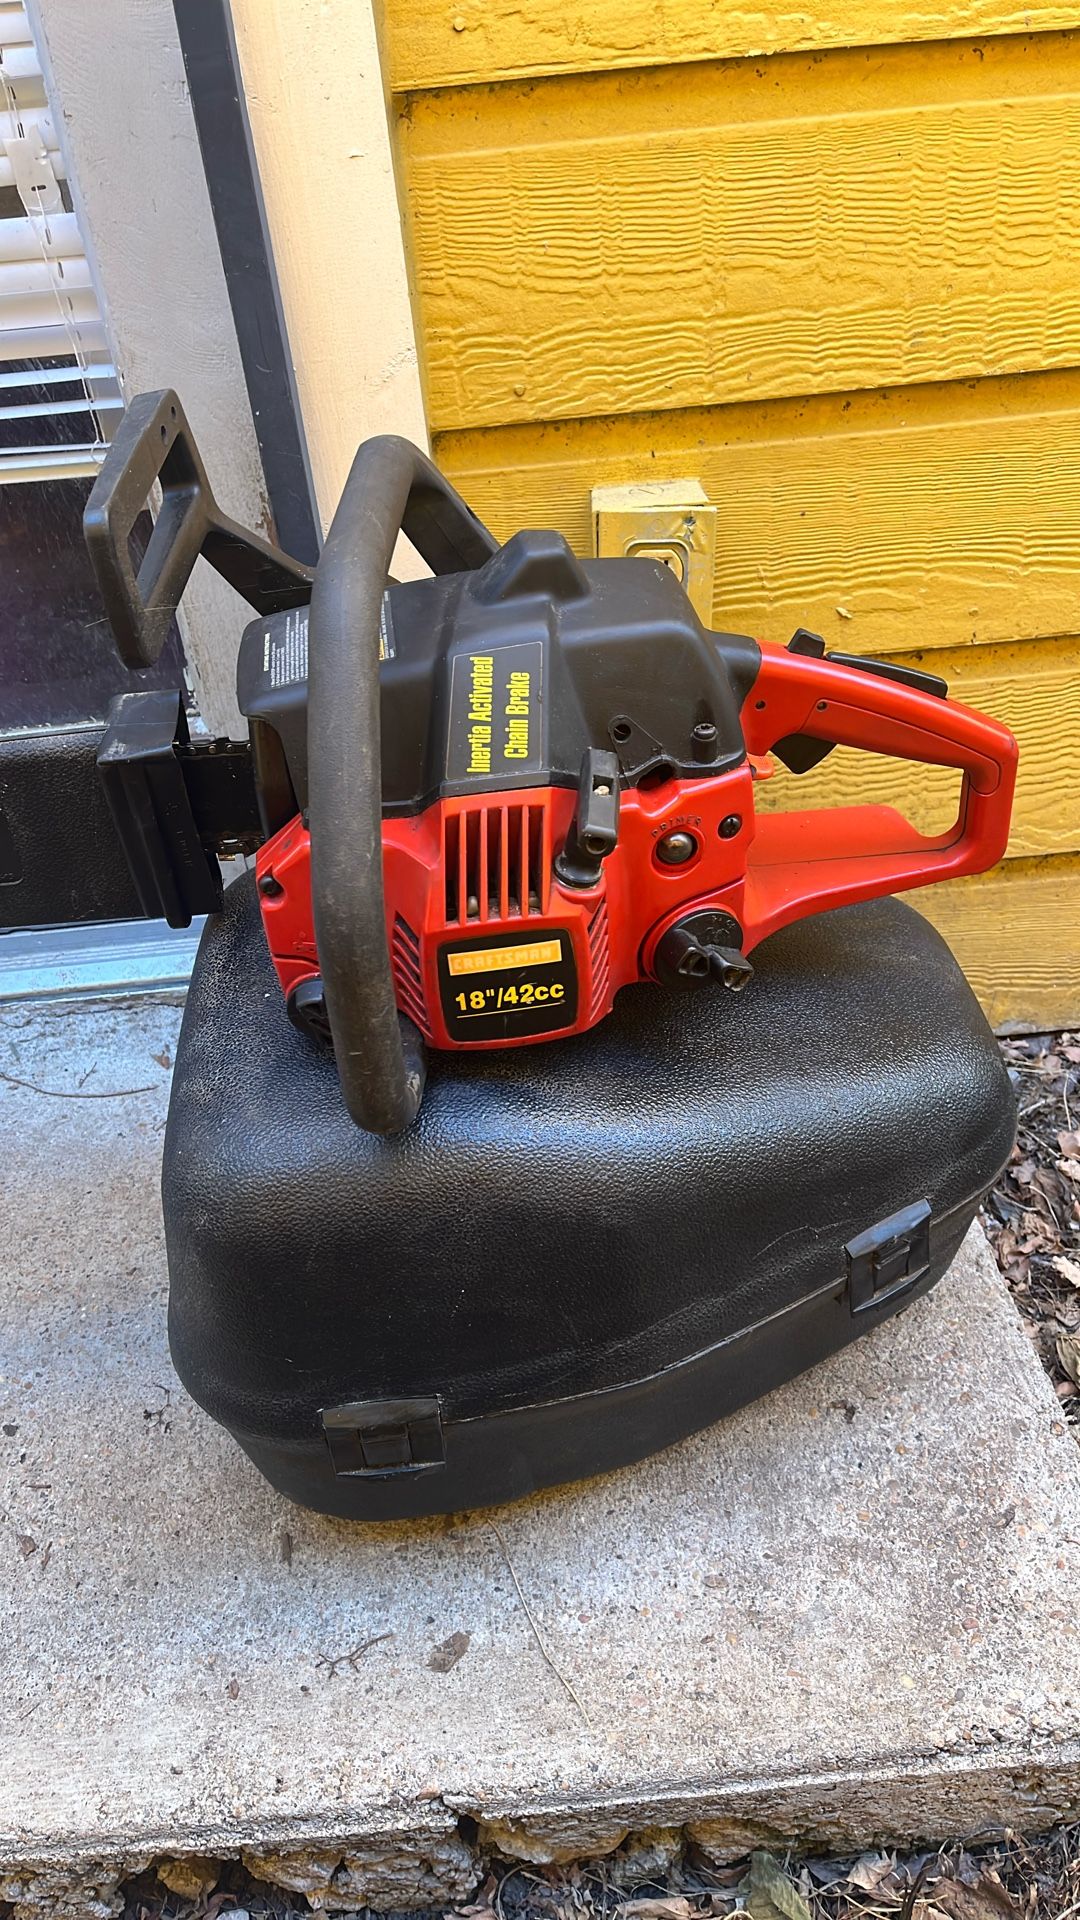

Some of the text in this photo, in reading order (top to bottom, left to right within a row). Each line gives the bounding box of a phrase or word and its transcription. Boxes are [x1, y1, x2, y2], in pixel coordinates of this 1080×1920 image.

[466, 656, 494, 773] Inertia Activated
[503, 671, 530, 758] Chain Brake
[651, 814, 702, 838] PRIMER
[452, 946, 553, 970] CRAFTSMAN
[455, 983, 565, 1011] 18"/42cc
